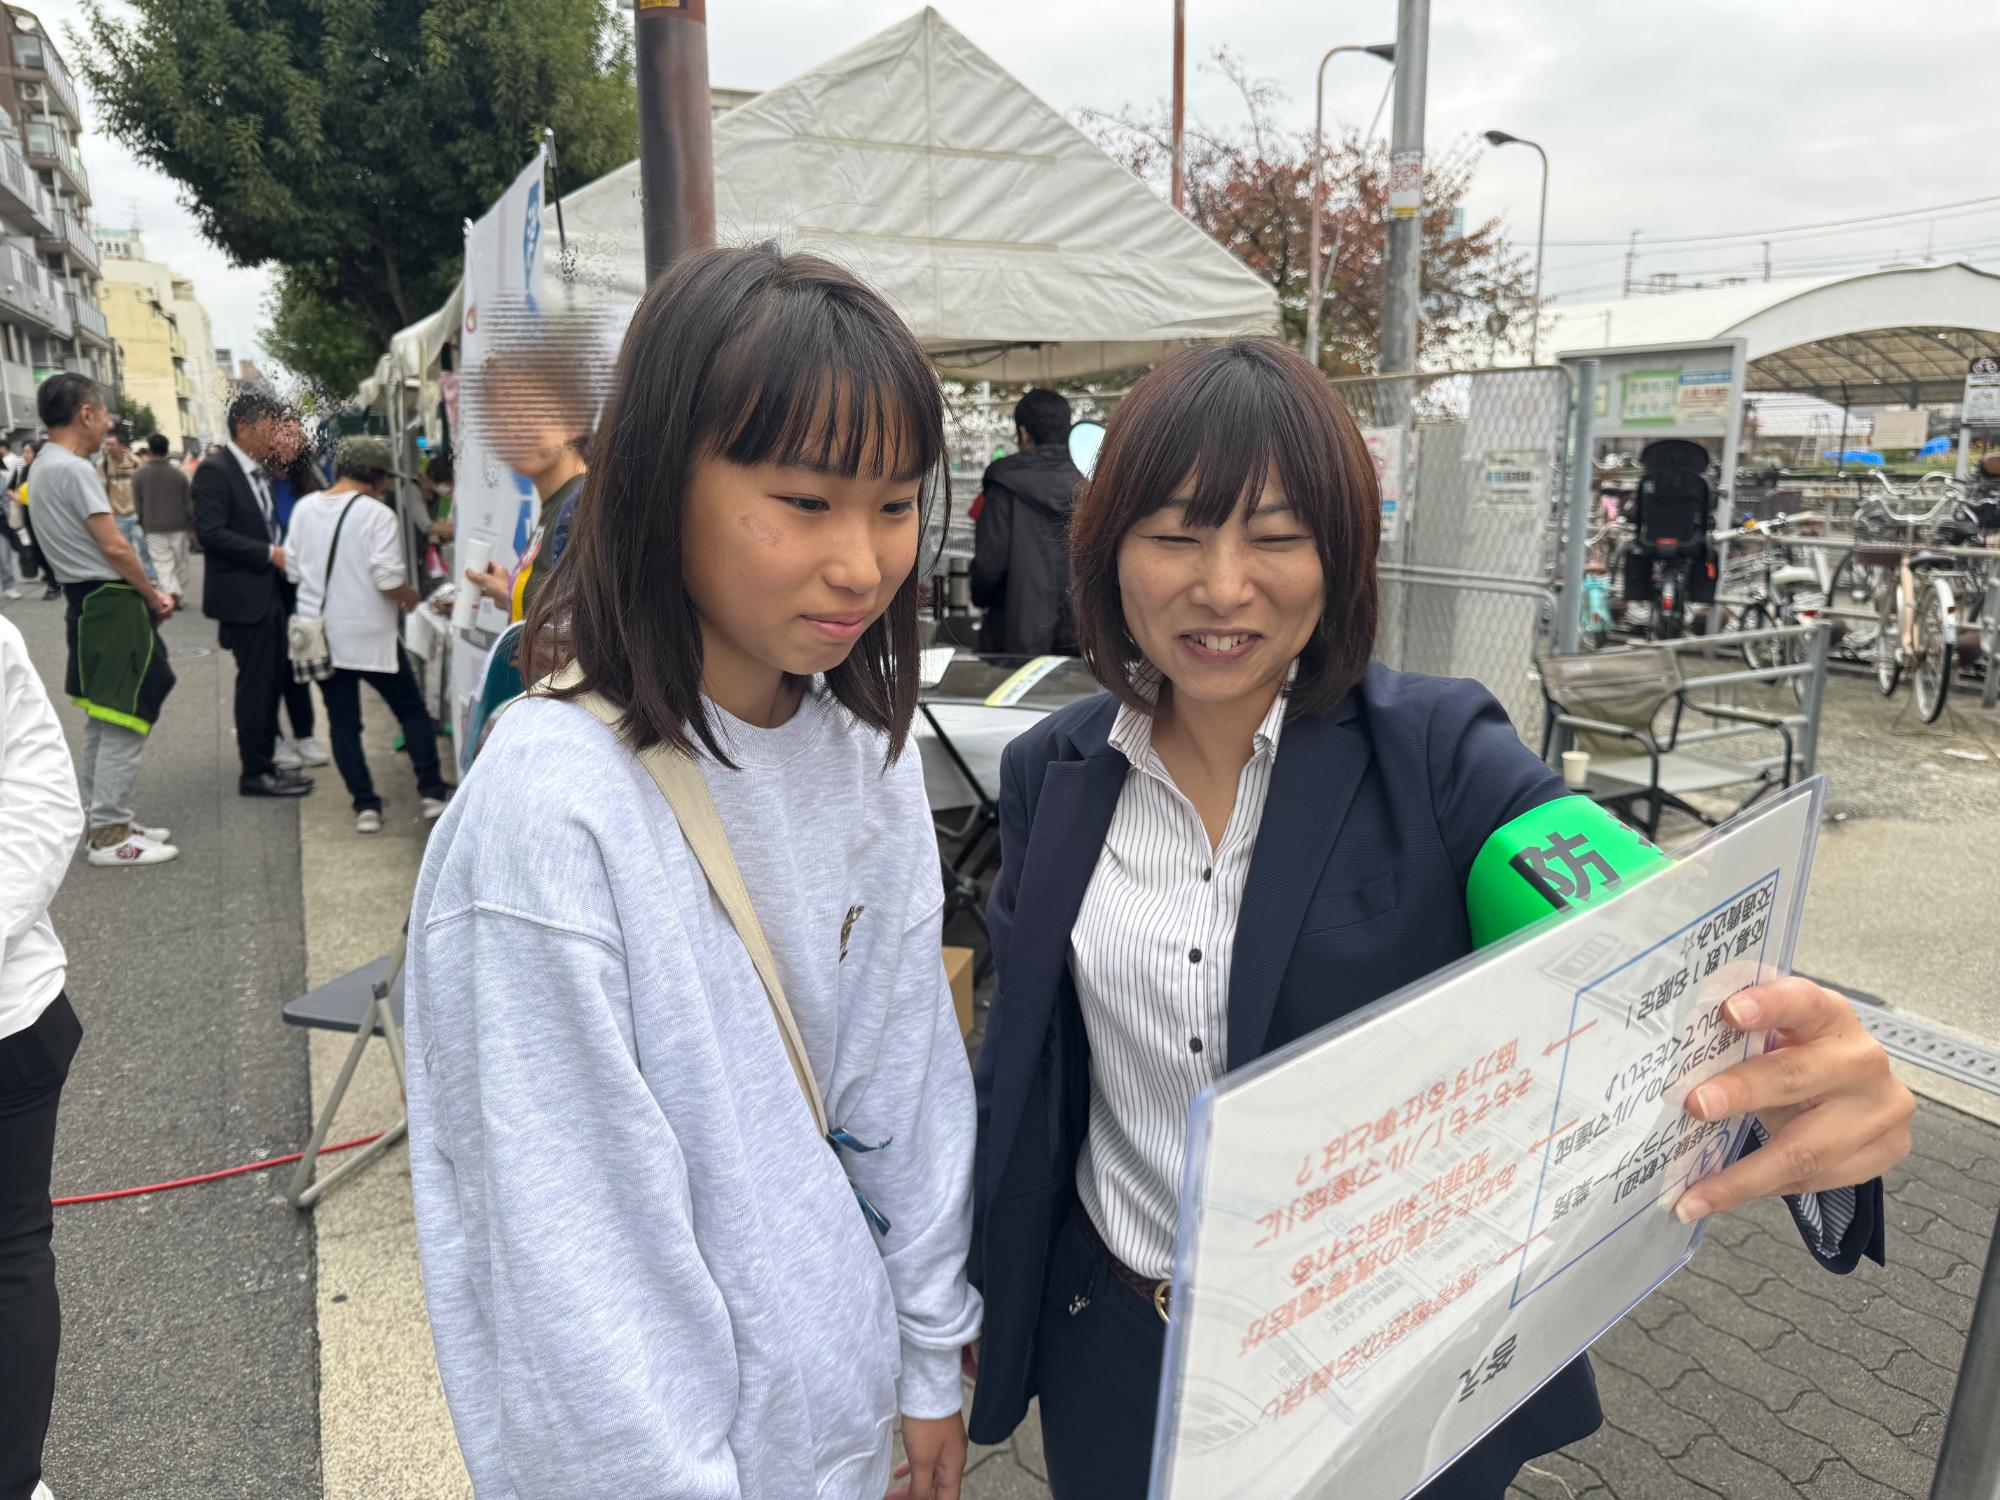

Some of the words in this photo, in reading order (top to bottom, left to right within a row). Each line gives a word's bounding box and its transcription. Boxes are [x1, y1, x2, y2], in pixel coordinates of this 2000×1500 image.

[1508, 814, 1652, 914] 防
[1253, 1068, 1534, 1248] そもそも「ノルマ達成」に
[1290, 1148, 1490, 1287] 犯罪に利用される
[1237, 1163, 1517, 1358] あなた名義の携帯電話が
[1458, 1334, 1517, 1404] 答え
